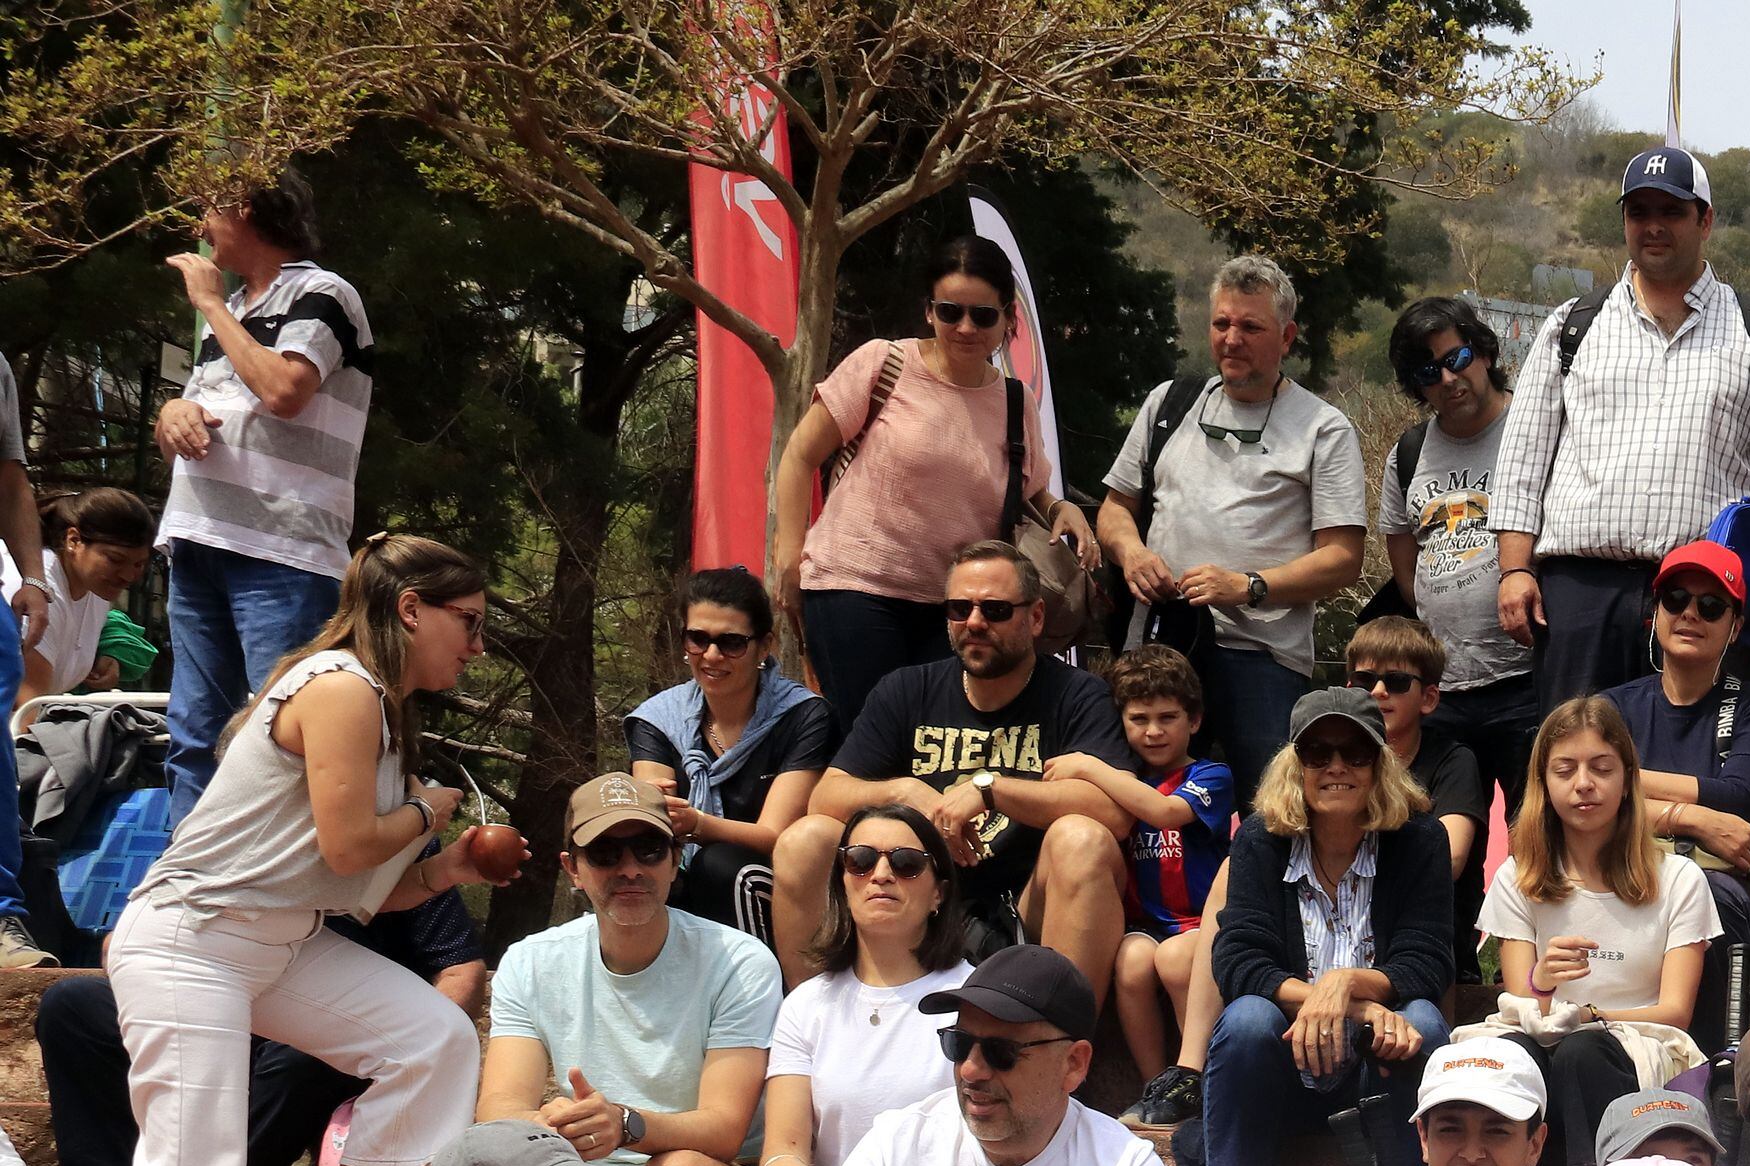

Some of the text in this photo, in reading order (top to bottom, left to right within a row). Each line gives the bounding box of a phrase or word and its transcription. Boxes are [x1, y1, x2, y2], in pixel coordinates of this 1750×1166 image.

[1429, 553, 1463, 577] Bier
[1716, 697, 1738, 738] BIMBA
[911, 724, 1044, 777] SIENA
[1130, 830, 1182, 848] ATAR
